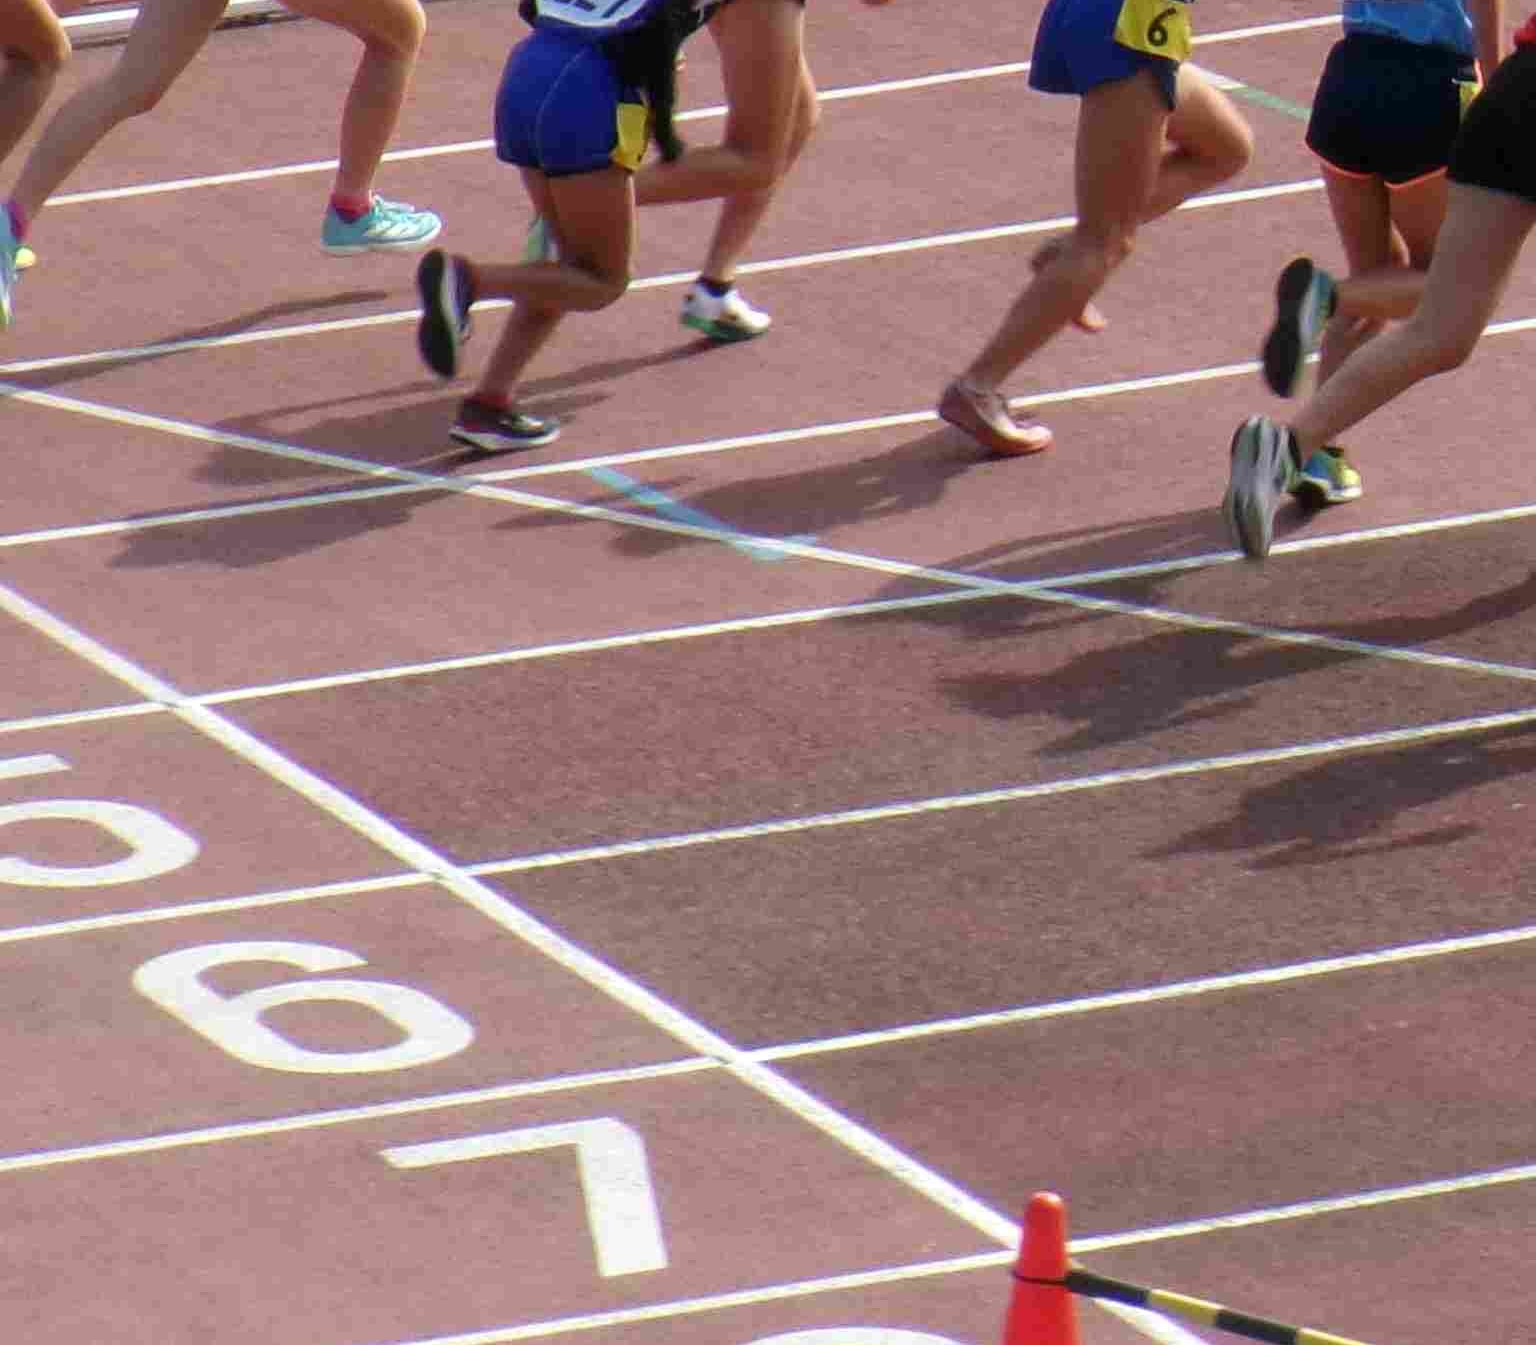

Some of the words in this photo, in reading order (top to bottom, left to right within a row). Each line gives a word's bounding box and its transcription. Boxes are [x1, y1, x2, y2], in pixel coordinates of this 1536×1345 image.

[1145, 7, 1178, 47] 6
[132, 940, 476, 1074] 6
[379, 1116, 669, 1277] 7
